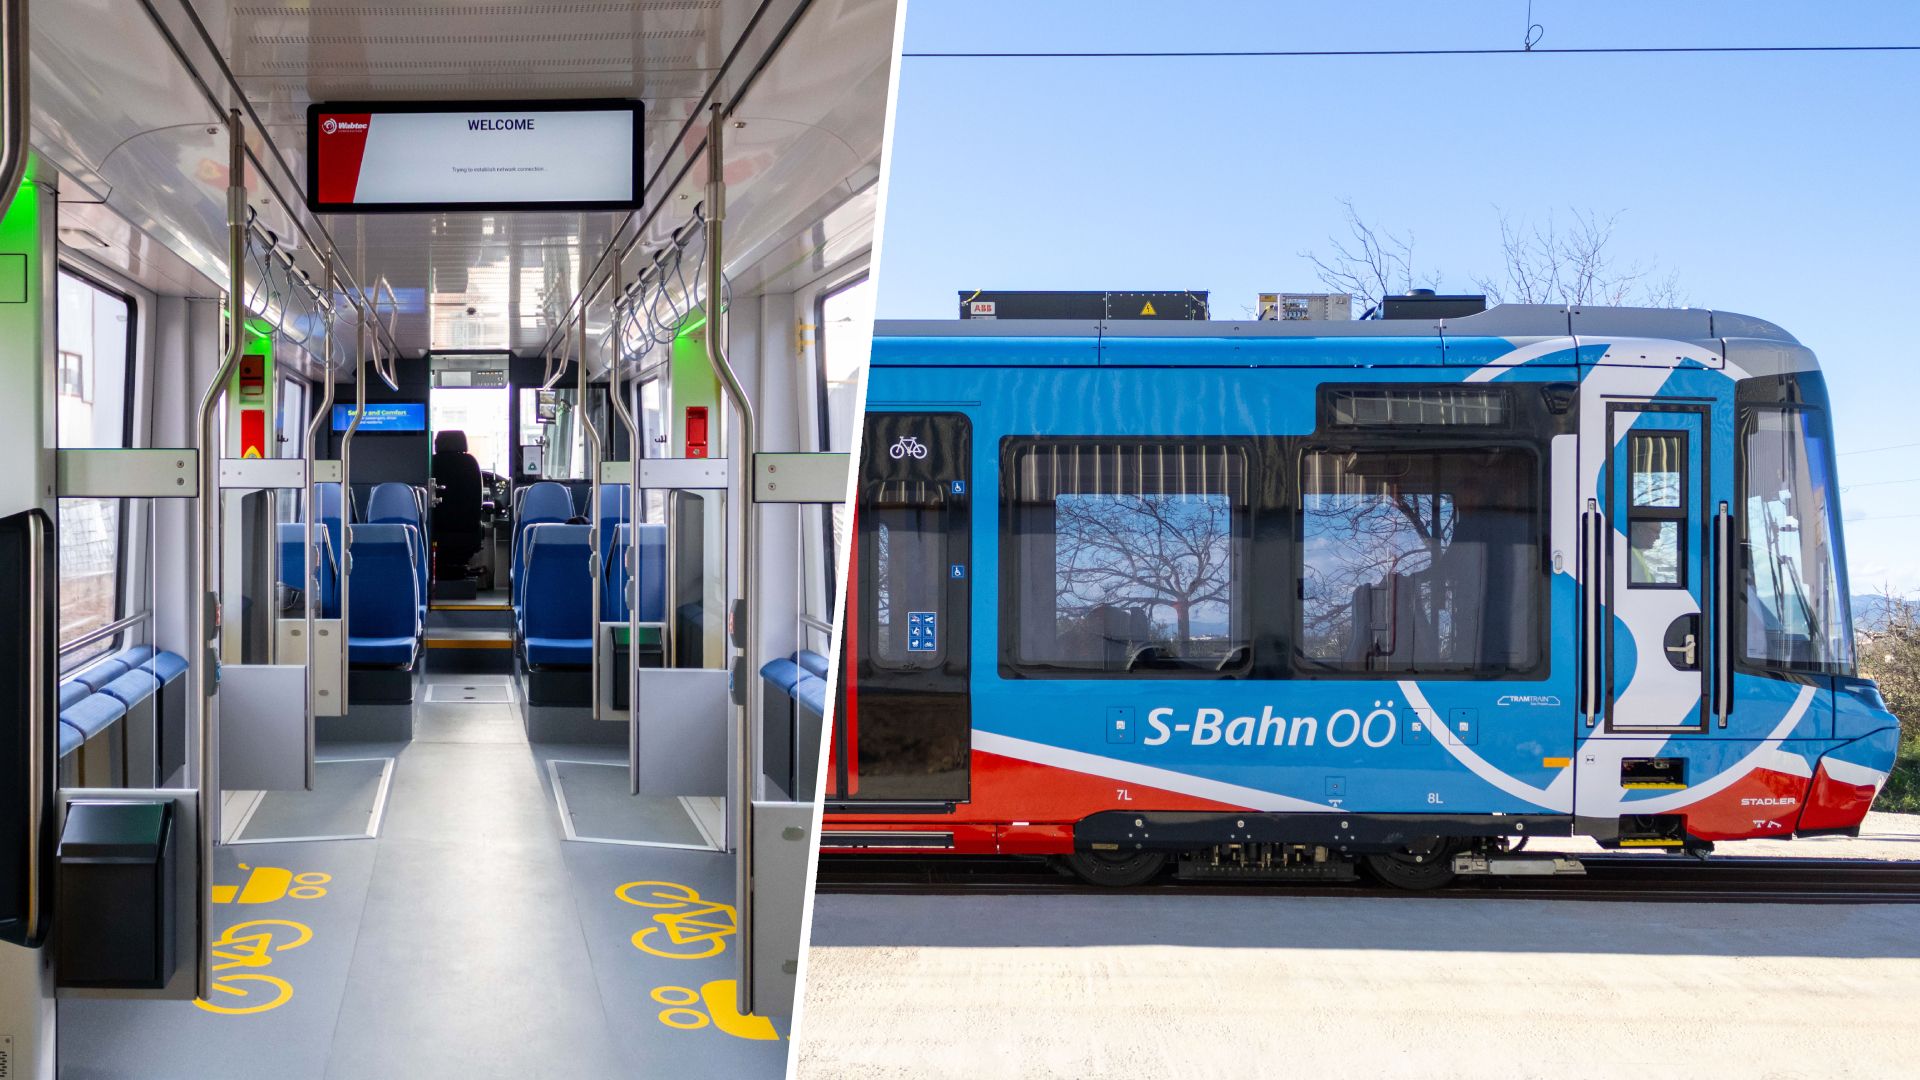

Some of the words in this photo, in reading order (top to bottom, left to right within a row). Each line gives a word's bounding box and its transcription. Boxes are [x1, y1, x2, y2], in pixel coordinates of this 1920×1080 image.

[467, 119, 535, 131] WELCOME
[974, 304, 992, 312] ABB
[1143, 705, 1318, 747] S-Bahn
[1326, 699, 1396, 748] OÖ
[1116, 789, 1132, 801] 7L
[1427, 793, 1443, 804] 8L
[1741, 797, 1796, 806] STADLER
